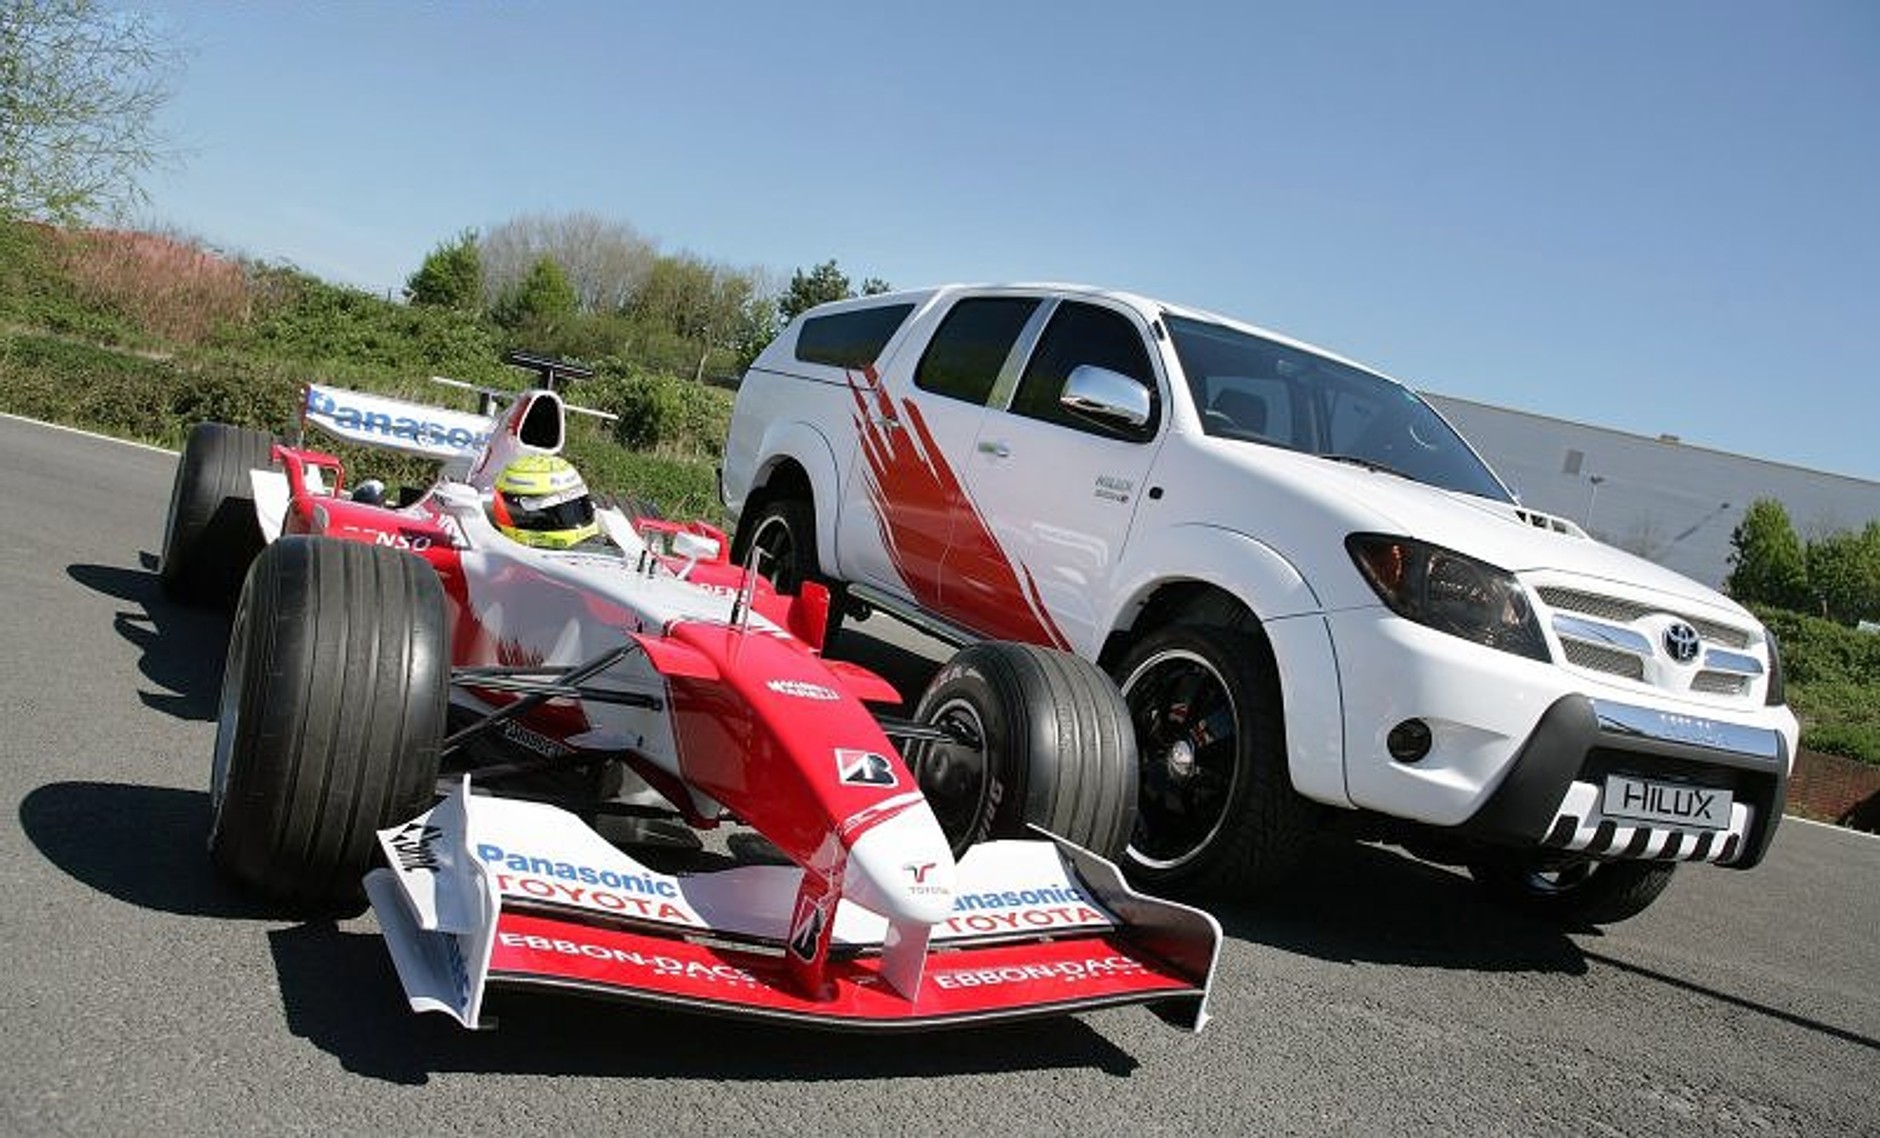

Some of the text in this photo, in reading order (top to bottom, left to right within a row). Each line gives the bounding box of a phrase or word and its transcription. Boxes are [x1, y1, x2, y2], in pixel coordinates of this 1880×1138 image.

[343, 526, 431, 552] NSO
[1623, 782, 1715, 819] HILUX
[477, 843, 677, 898] Panasonic
[496, 874, 692, 922] TOYOTA
[952, 884, 1082, 911] nasonic
[946, 907, 1103, 934] TOYOTA
